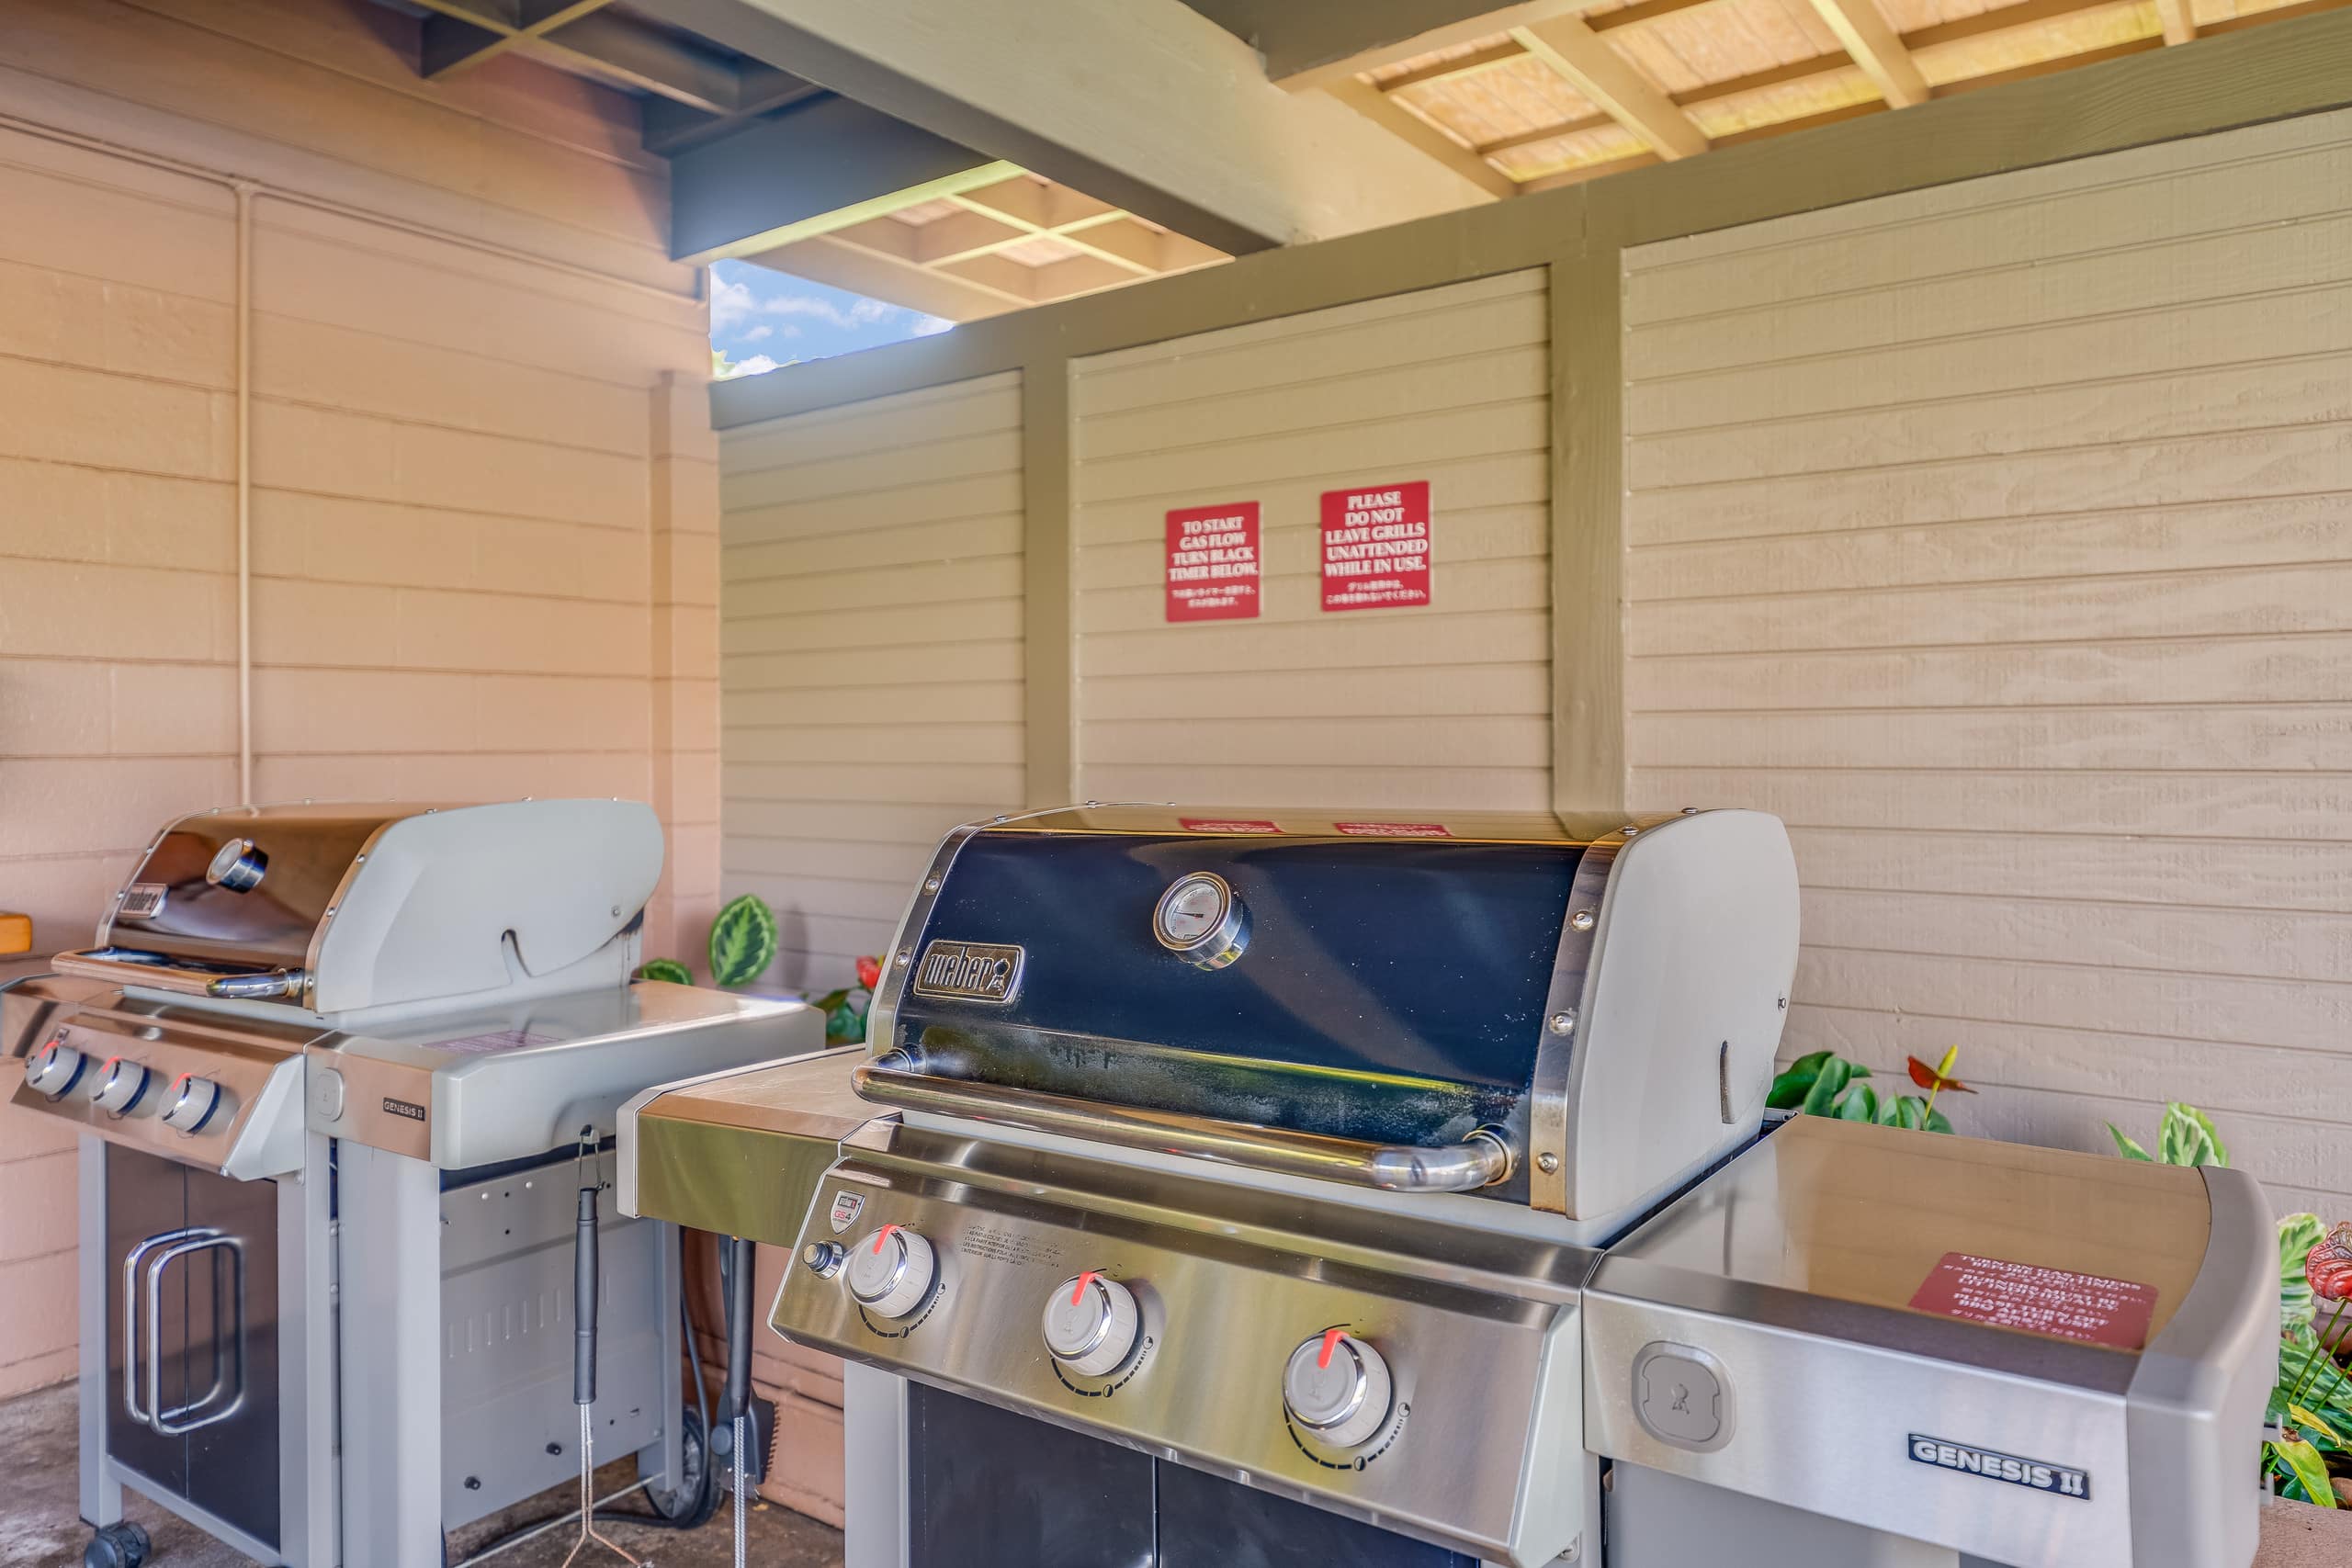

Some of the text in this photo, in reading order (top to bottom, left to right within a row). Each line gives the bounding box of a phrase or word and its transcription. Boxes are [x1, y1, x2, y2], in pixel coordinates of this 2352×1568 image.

[1347, 491, 1402, 511] PLEASE
[1182, 516, 1245, 535] TO START
[1344, 507, 1405, 526] DO NOT
[1180, 532, 1247, 550] GAS FLOW
[1325, 522, 1426, 545] LEAVE GRILLS
[1171, 547, 1254, 566] TURN BLACK
[1326, 539, 1428, 561] UNATTENDED
[1169, 566, 1209, 581] TIMER
[1324, 556, 1427, 577] WHILE IN USE.
[924, 946, 994, 990] weber
[384, 1101, 416, 1116] GENESIS
[1913, 1440, 2084, 1497] GENESIS II
